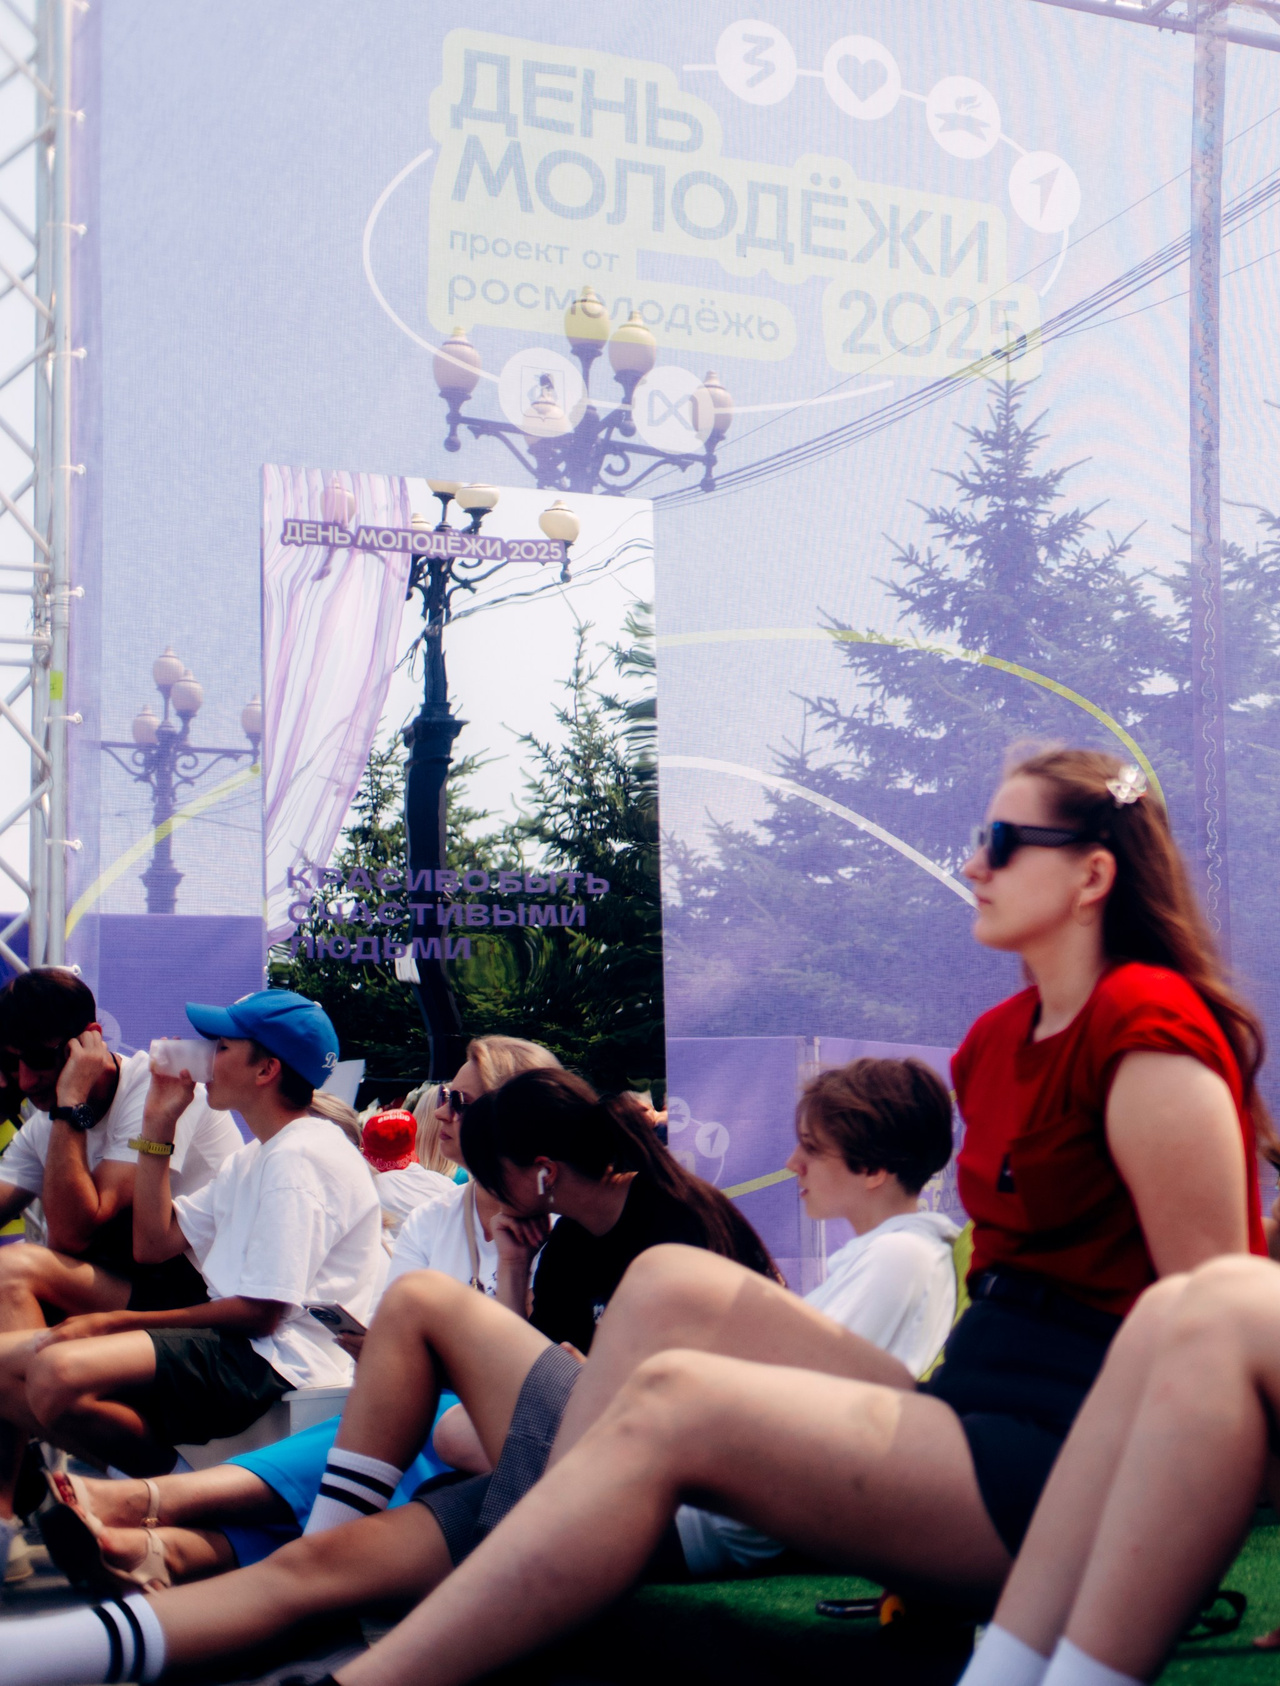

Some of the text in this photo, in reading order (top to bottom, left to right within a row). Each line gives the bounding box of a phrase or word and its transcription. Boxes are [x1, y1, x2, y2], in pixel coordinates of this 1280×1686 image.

[450, 48, 704, 154] ДЕНЬ
[451, 134, 989, 284] МОЛОДЁЖИ
[450, 229, 620, 273] проект от
[448, 273, 780, 343] росмолодёжь
[838, 289, 1028, 364] 2025
[283, 521, 563, 561] ДЕНЬ МОЛОДЁЖИ 2025
[286, 866, 611, 895] КРАСИВО БЫТЬ
[286, 901, 587, 927] СЧАСТИВЫМИ
[286, 935, 472, 965] ЛЮДЬМИ
